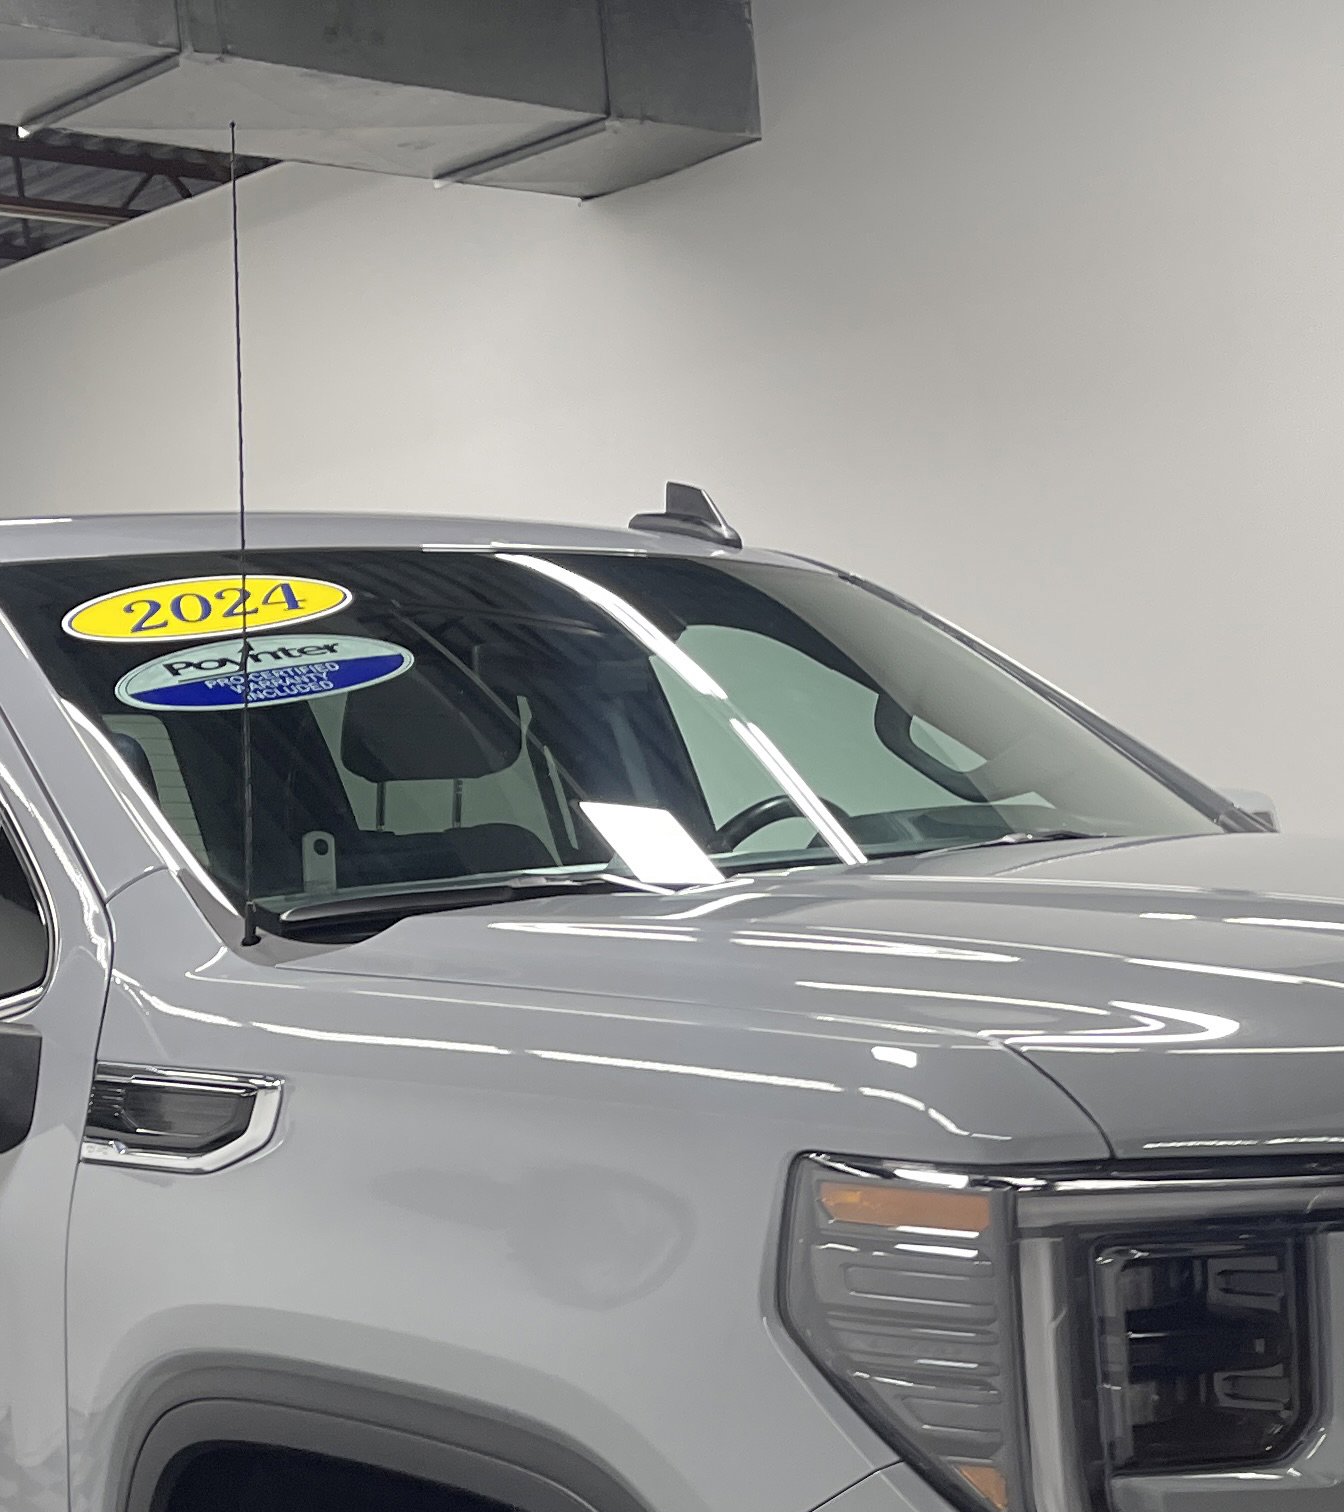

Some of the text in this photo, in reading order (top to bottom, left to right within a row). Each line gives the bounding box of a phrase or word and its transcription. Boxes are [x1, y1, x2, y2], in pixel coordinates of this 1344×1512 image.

[123, 583, 308, 633] 2024
[162, 641, 340, 677] Poynter
[229, 671, 329, 694] WARRANTY
[247, 680, 335, 701] INCLUDED
